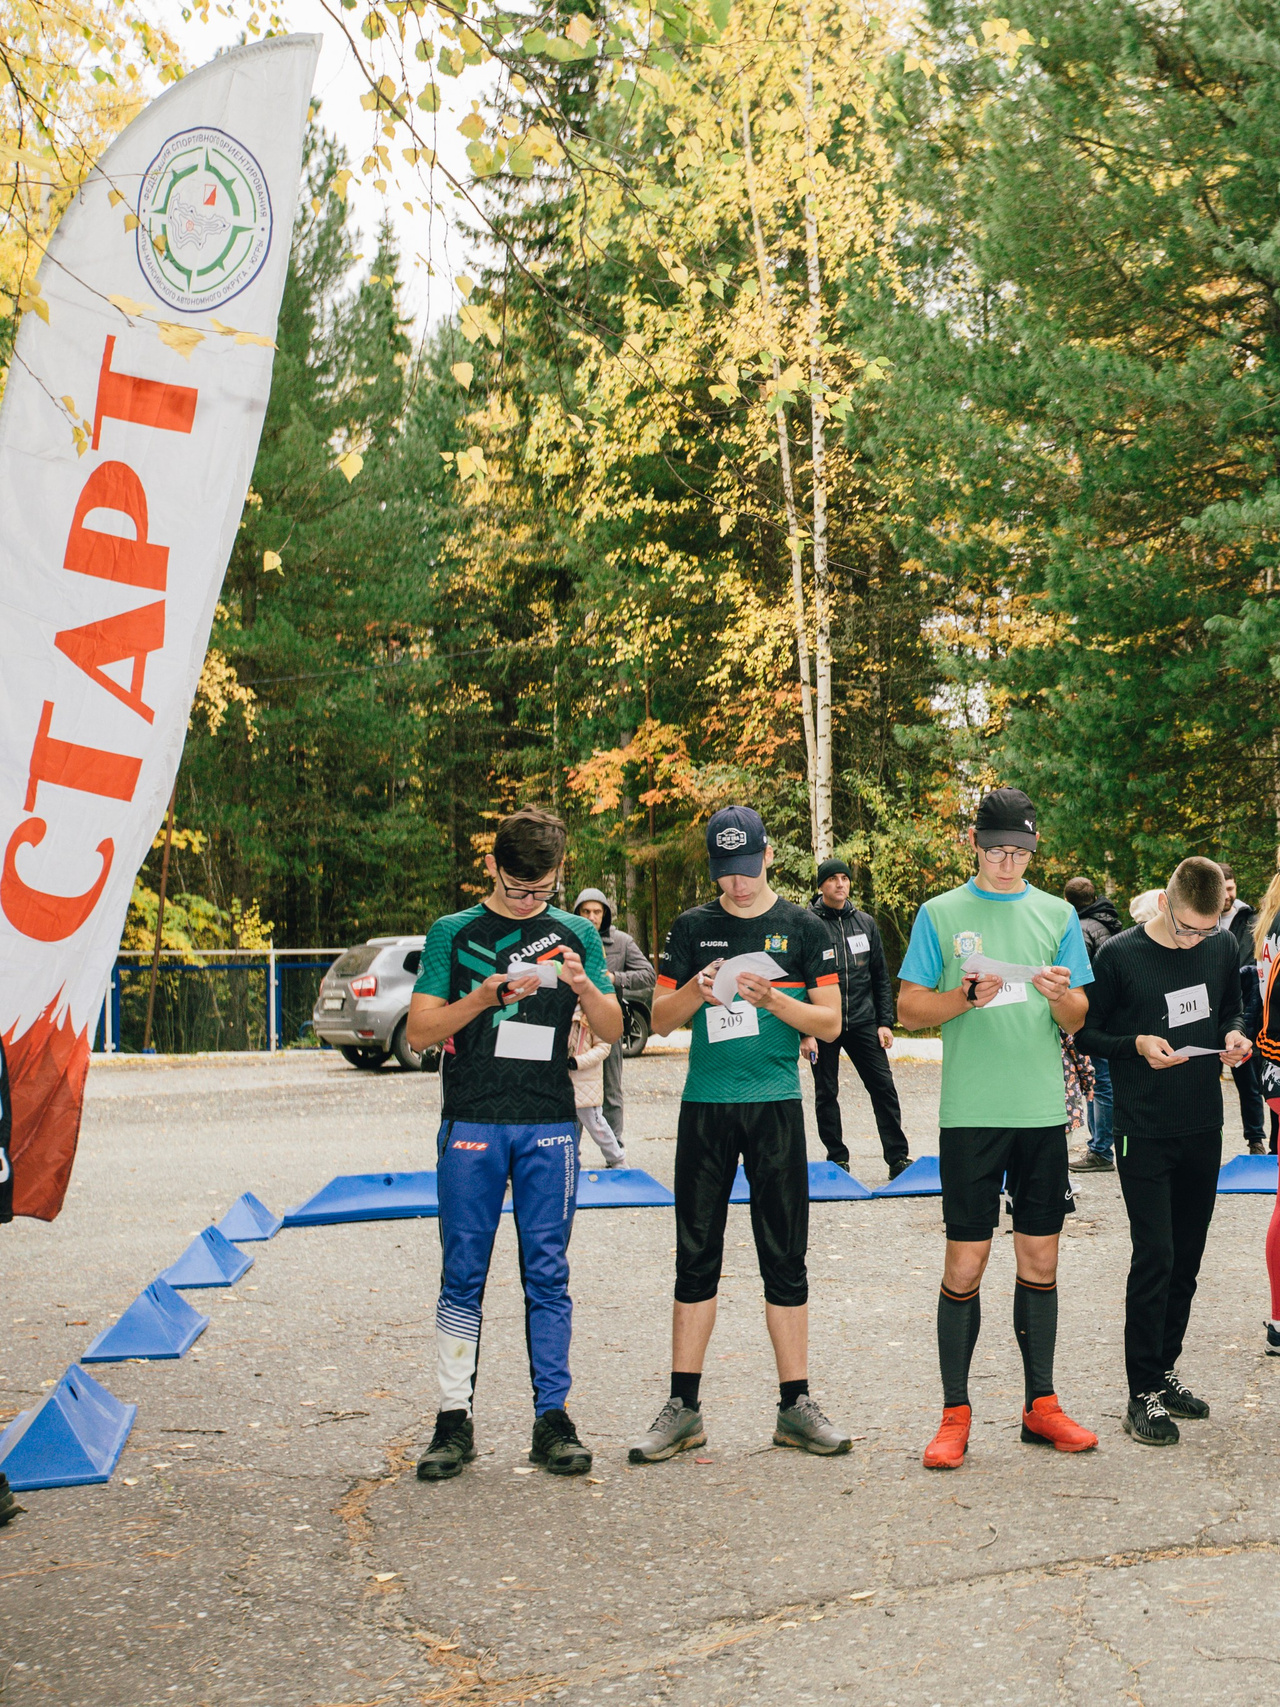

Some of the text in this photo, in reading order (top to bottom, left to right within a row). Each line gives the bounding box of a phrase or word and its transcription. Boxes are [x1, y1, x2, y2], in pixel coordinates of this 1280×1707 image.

[141, 225, 177, 300] АНТЫ-МАНСИЙСКОГО
[1, 334, 199, 942] СТАРТ
[700, 940, 729, 948] O-UGRA
[1179, 999, 1198, 1015] 201
[720, 1014, 743, 1030] 209
[537, 1134, 573, 1148] ЮГРА
